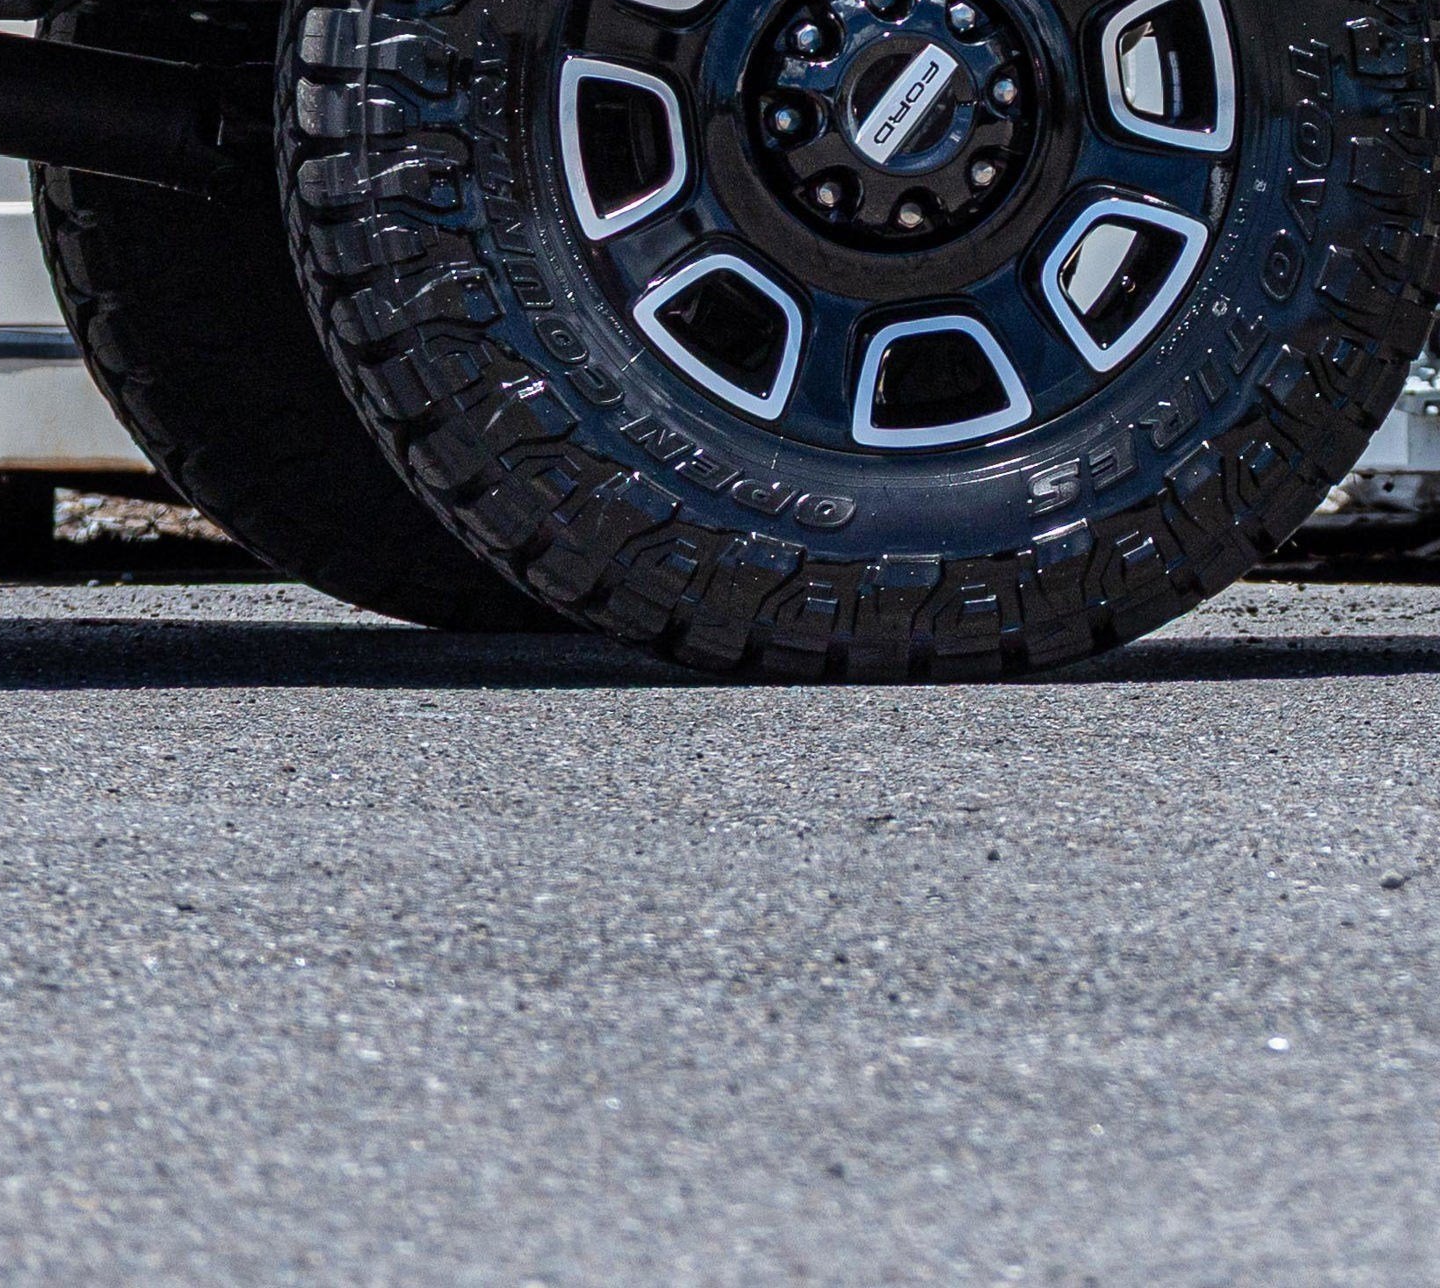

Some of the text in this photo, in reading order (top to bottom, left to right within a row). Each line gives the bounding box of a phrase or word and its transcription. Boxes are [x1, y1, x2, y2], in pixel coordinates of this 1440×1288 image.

[872, 60, 941, 145] FORD
[1028, 38, 1335, 519] TOYO TIRES
[619, 413, 858, 529] OPEN
